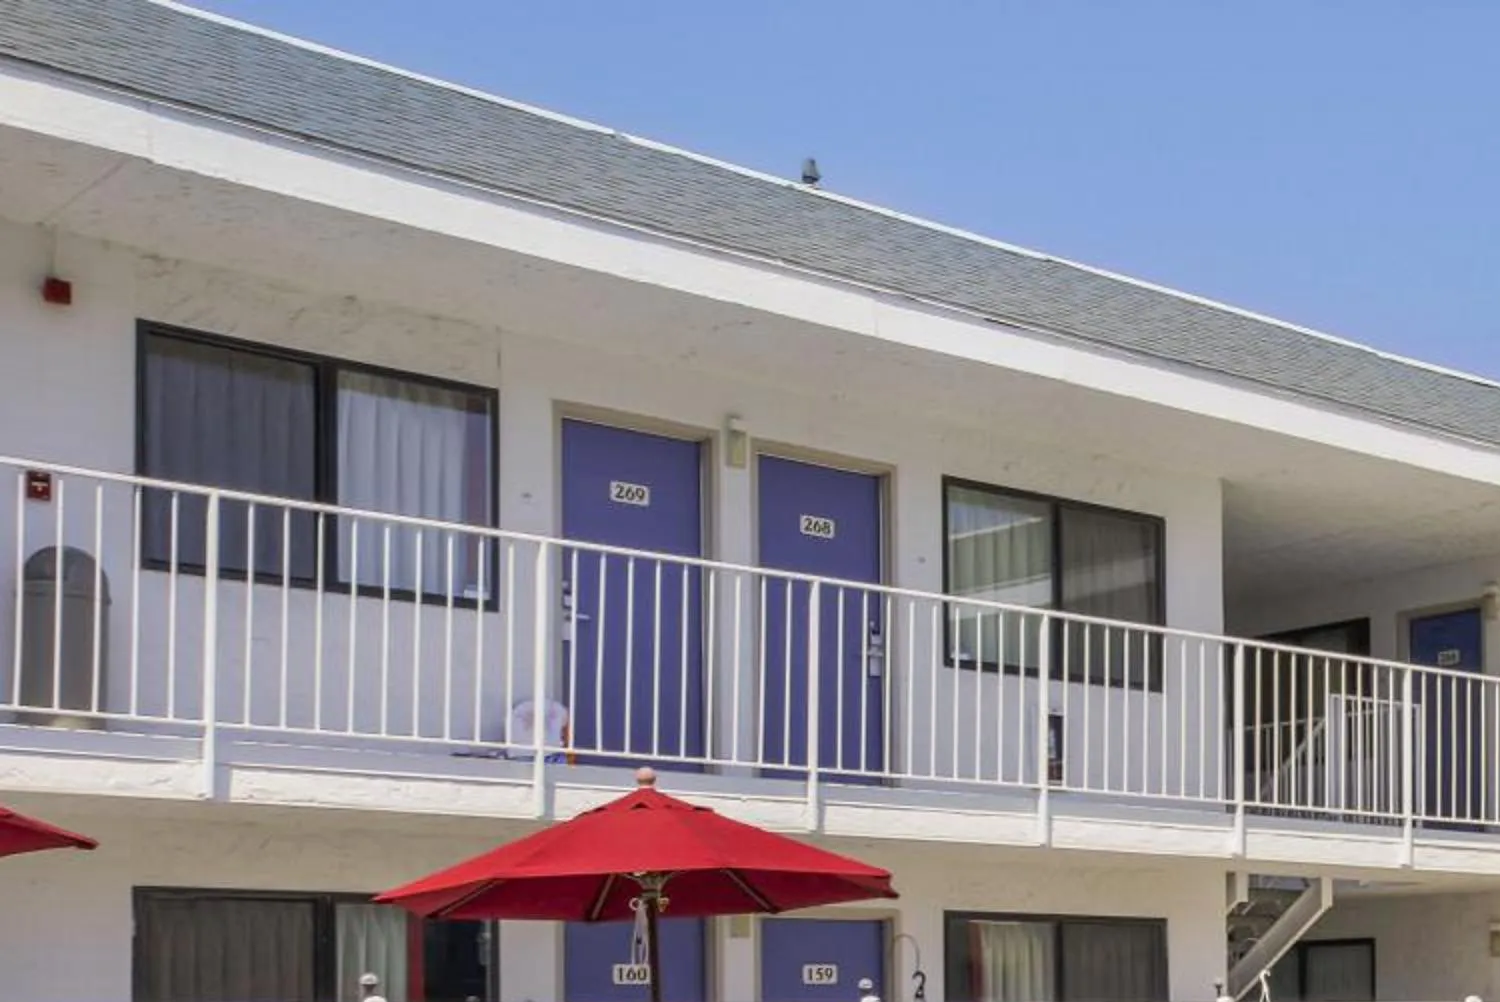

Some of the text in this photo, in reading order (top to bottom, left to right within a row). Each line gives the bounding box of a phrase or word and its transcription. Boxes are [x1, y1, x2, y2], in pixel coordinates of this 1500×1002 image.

[615, 484, 645, 501] 269
[804, 518, 831, 535] 268
[618, 967, 647, 981] 160
[808, 967, 833, 981] 159
